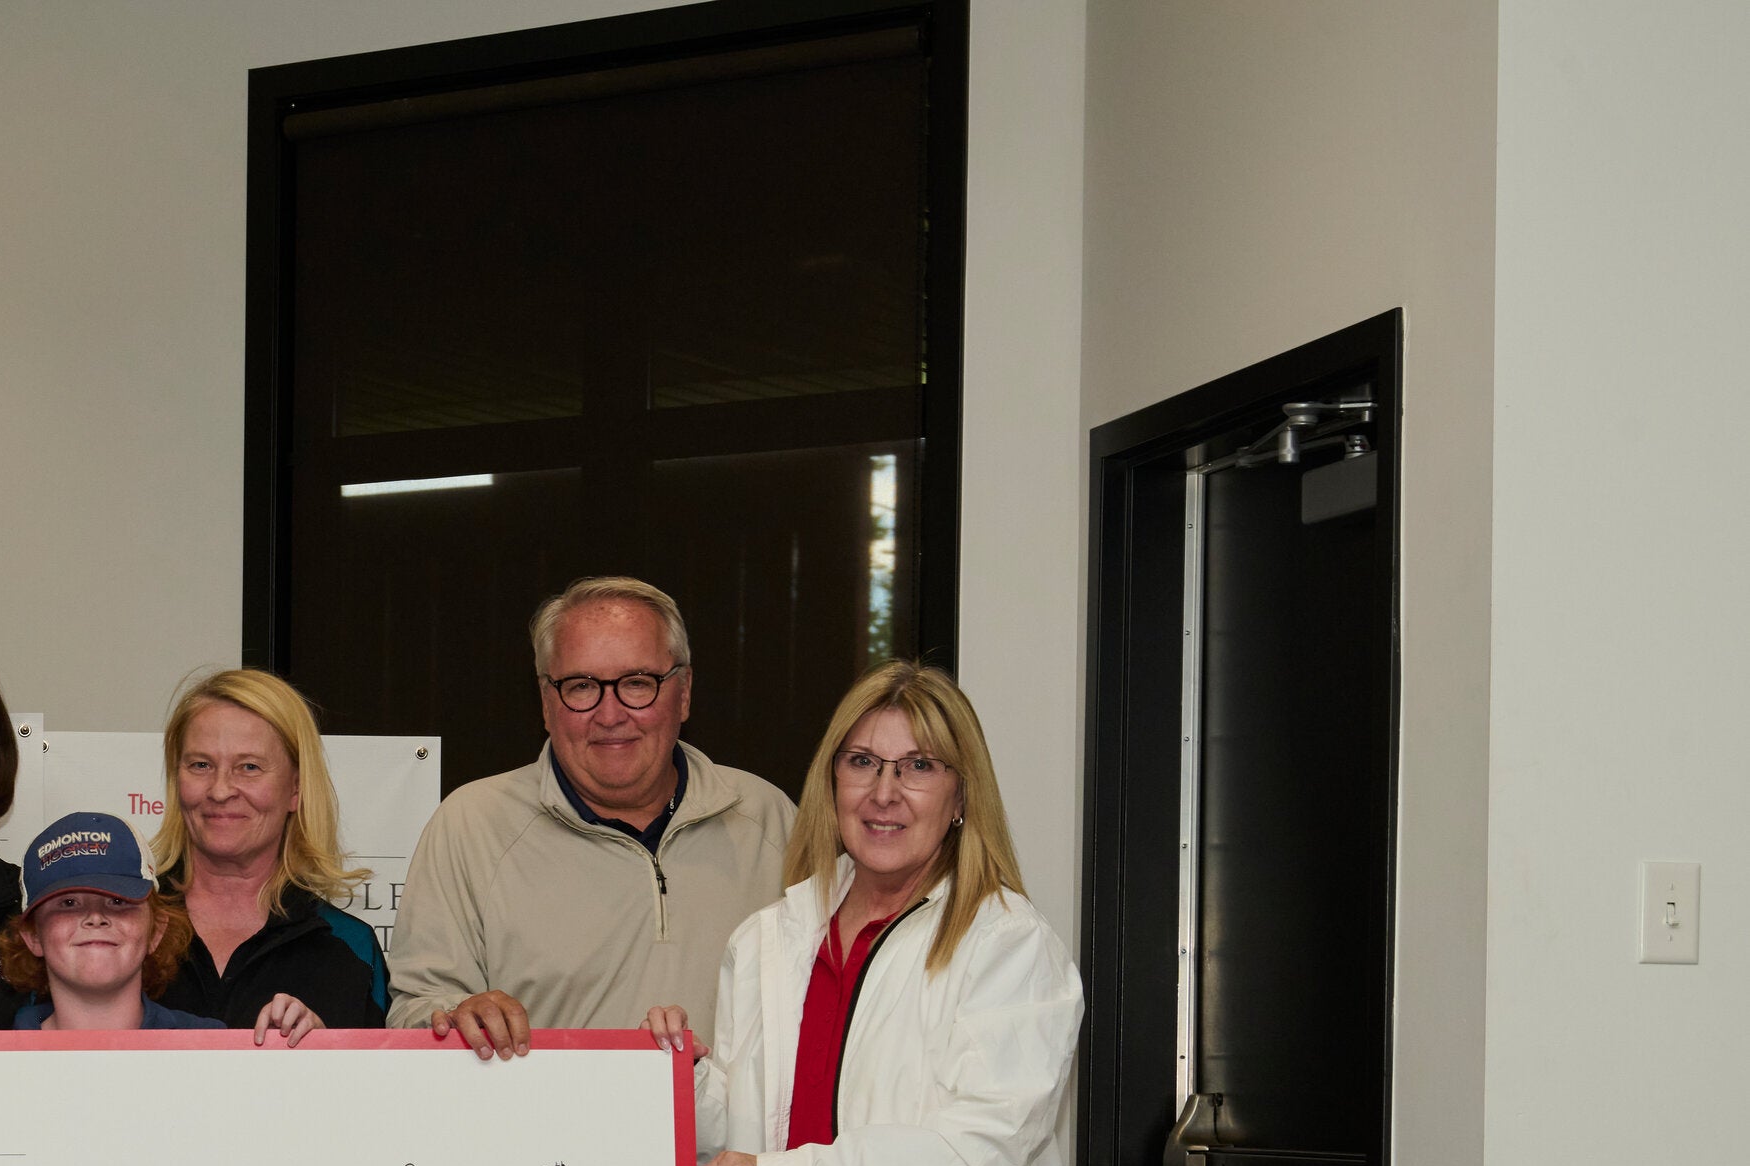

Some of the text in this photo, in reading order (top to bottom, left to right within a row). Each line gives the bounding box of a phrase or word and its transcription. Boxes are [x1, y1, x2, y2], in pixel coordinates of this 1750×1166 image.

[127, 793, 165, 815] The
[37, 831, 112, 858] EDMONTON
[40, 842, 109, 871] HOCKEY
